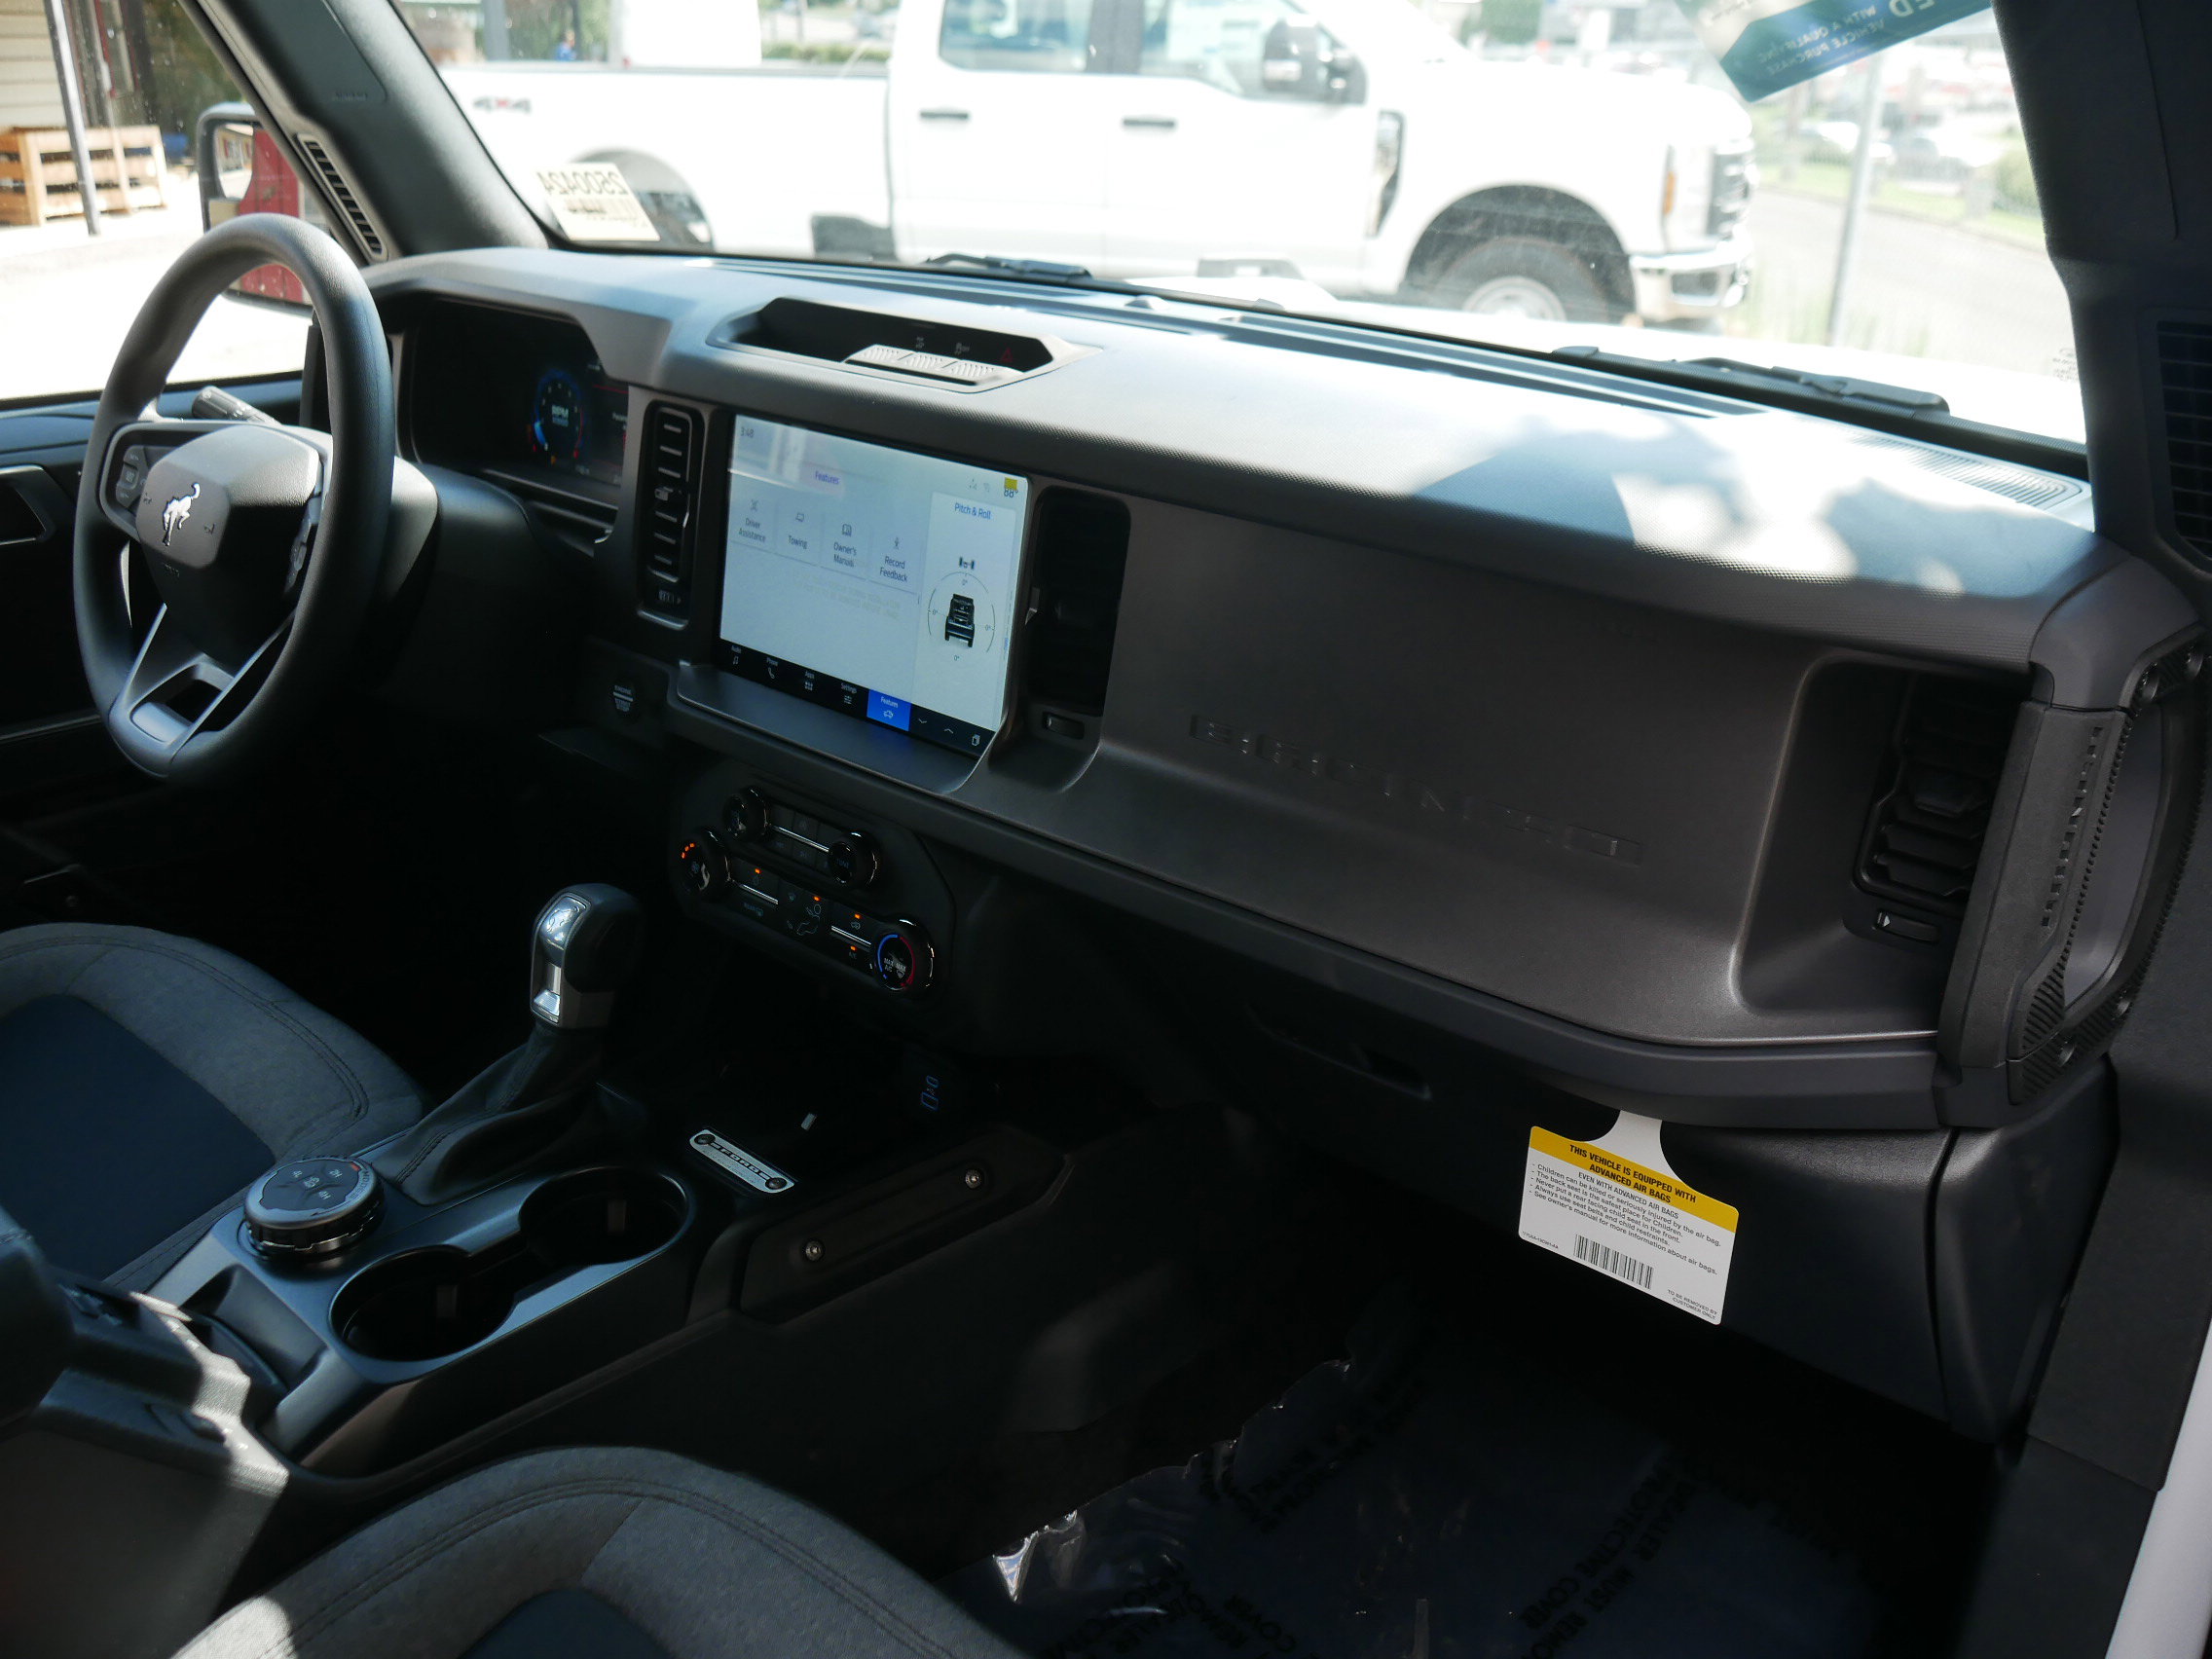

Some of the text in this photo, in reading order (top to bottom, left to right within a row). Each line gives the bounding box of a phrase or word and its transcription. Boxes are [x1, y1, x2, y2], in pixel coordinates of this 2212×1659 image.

[740, 426, 754, 438] 3:48
[815, 471, 840, 484] Features
[955, 503, 991, 519] Pitch & Roll
[738, 526, 766, 543] Assistance
[788, 535, 807, 550] Towing
[833, 541, 857, 556] Owner's
[884, 557, 905, 570] Record
[880, 568, 908, 582] Feedback
[881, 696, 898, 709] Features
[1569, 1144, 1696, 1202] THIS VEHICLE IS EQUIPPED WITH
[1589, 1162, 1671, 1203] ADVANCED AIR BAGS
[1536, 1169, 1549, 1180] The
[1550, 1175, 1566, 1187] back
[1567, 1183, 1580, 1194] seat
[1589, 1192, 1600, 1201] the
[1601, 1197, 1621, 1210] safest
[1622, 1206, 1640, 1219] place
[1641, 1214, 1651, 1223] for
[1652, 1219, 1683, 1236] Children.
[1537, 1162, 1564, 1179] Children
[1566, 1176, 1577, 1185] can
[1588, 1184, 1605, 1197] killed
[1616, 1197, 1646, 1215] seriously
[1647, 1210, 1671, 1226] injured
[1673, 1220, 1681, 1231] by
[1682, 1225, 1694, 1235] the
[1695, 1230, 1705, 1239] air
[1706, 1235, 1721, 1247] bag.
[1578, 1171, 1678, 1219] EVEN WITH ADVANCED AIR BAGS
[1534, 1183, 1670, 1246] Always use seat belts and child restraints.
[1535, 1177, 1554, 1190] Never
[1556, 1186, 1566, 1195] put
[1572, 1194, 1586, 1202] rear
[1587, 1198, 1607, 1213] facing
[1608, 1207, 1625, 1220] child
[1626, 1215, 1641, 1226] seat
[1650, 1225, 1661, 1235] the
[1662, 1231, 1680, 1243] front.
[1533, 1190, 1717, 1275] See owner's manual for more information about air bags.
[1672, 1296, 1714, 1319] CUSTOMER ONLY
[1683, 1297, 1709, 1311] REMOVED
[1521, 1478, 1698, 1659] DEALER MUST REMO
